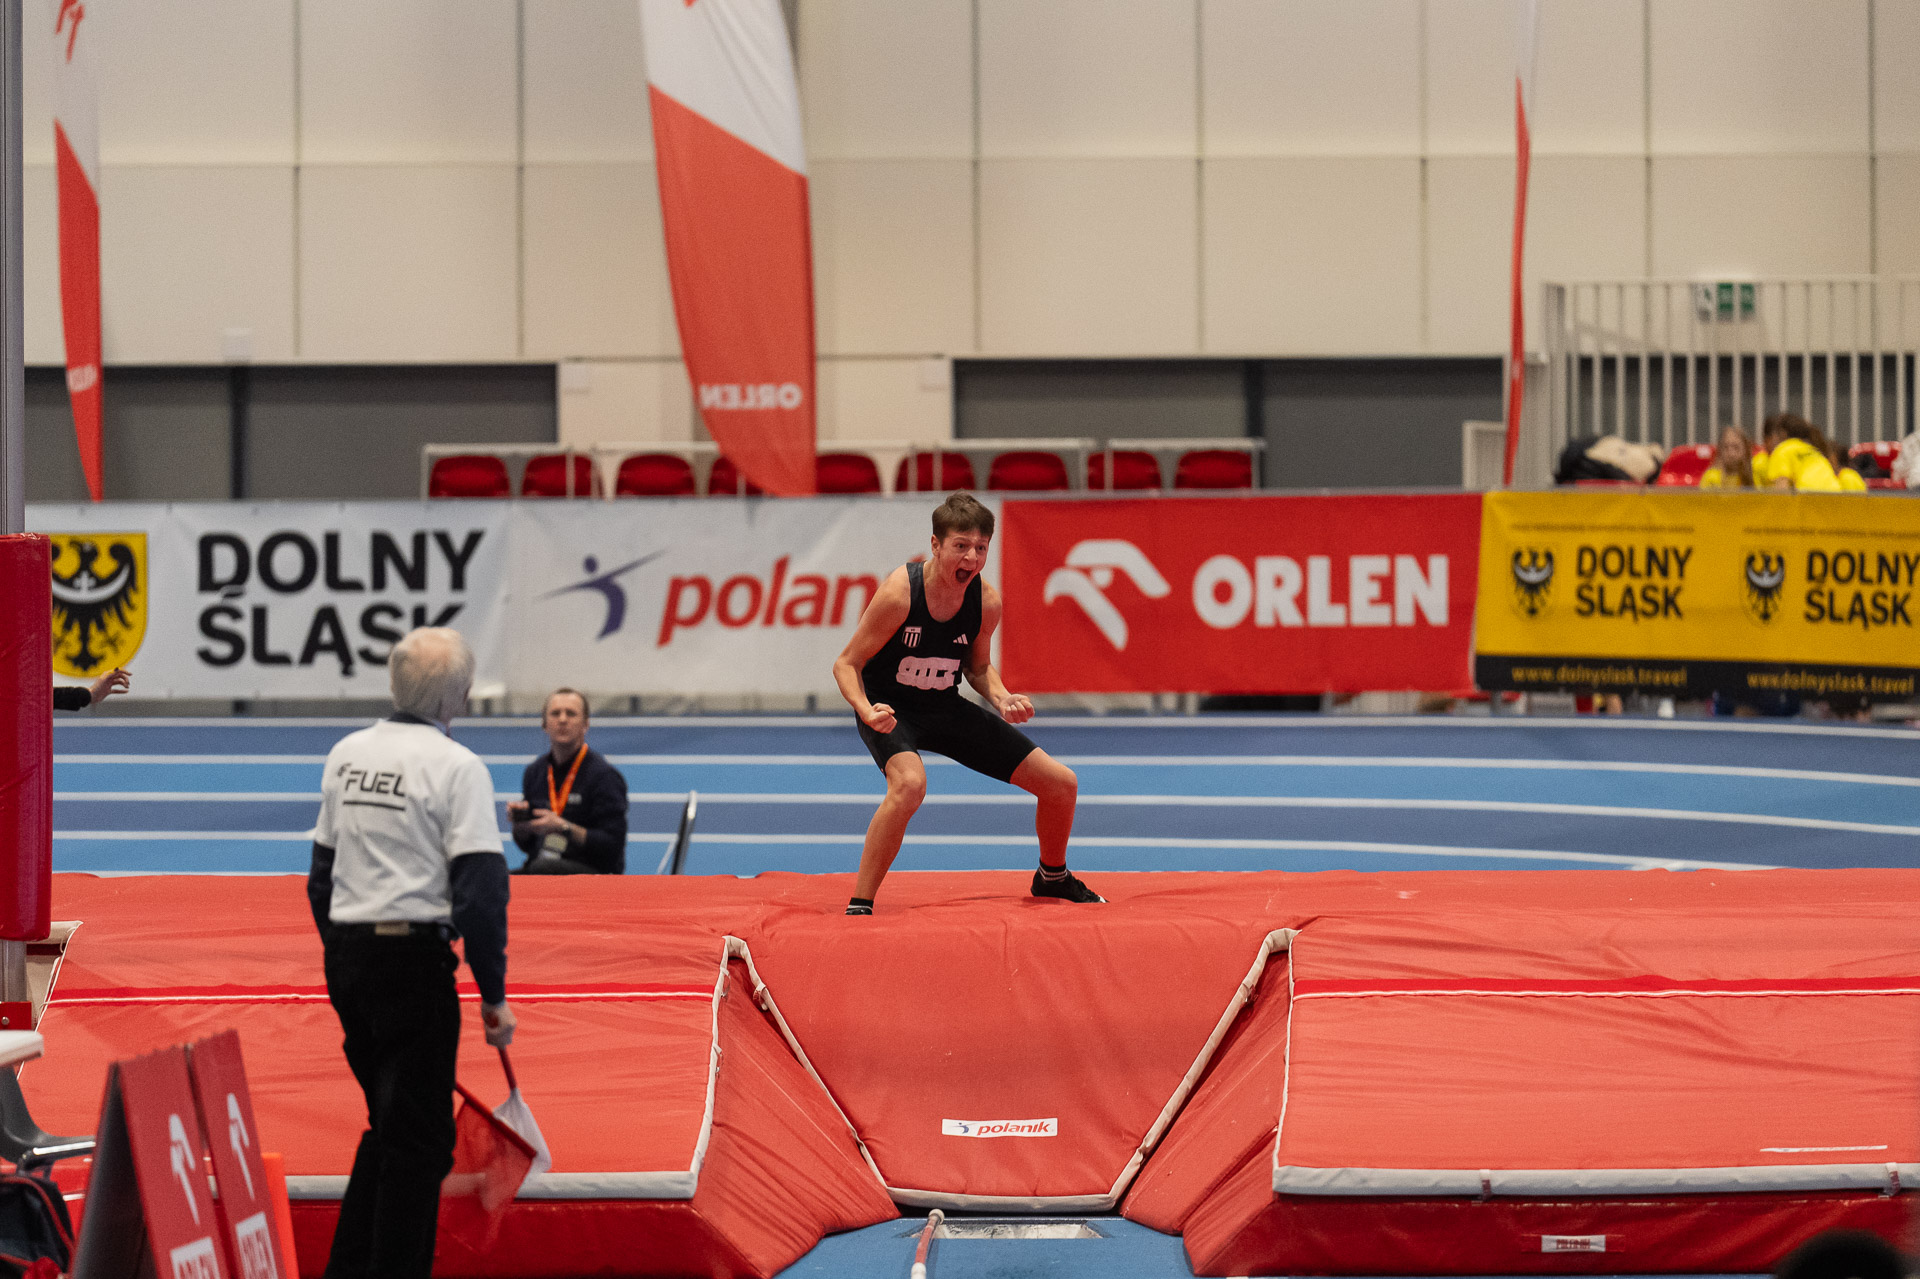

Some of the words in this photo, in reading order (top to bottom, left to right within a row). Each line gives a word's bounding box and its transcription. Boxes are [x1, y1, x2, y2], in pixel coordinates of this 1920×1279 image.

[198, 530, 485, 593] DOLNY
[1577, 545, 1692, 580] DOLNY
[1806, 549, 1920, 586] DOLNY
[656, 553, 925, 648] polan
[1193, 554, 1449, 629] ORLEN
[345, 771, 405, 797] FUEL
[977, 1121, 1051, 1136] polanik
